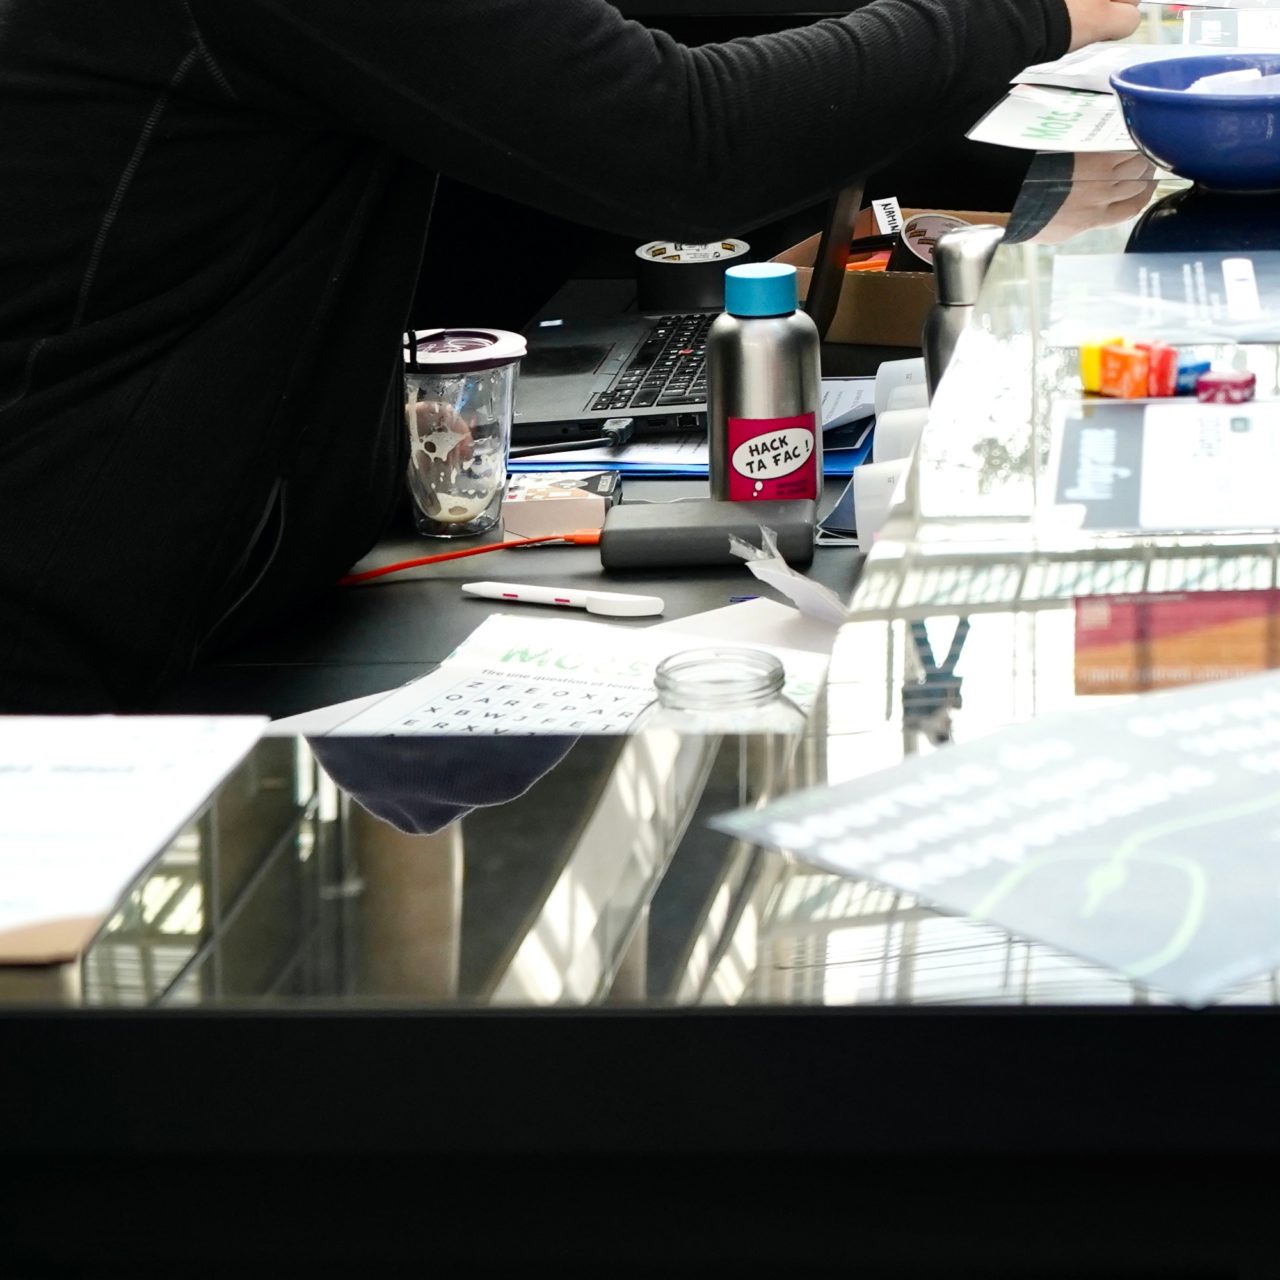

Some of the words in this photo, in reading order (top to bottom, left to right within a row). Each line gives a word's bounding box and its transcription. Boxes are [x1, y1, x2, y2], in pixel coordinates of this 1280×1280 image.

[748, 435, 788, 457] HACK
[746, 459, 767, 474] TA
[772, 446, 801, 466] FAC
